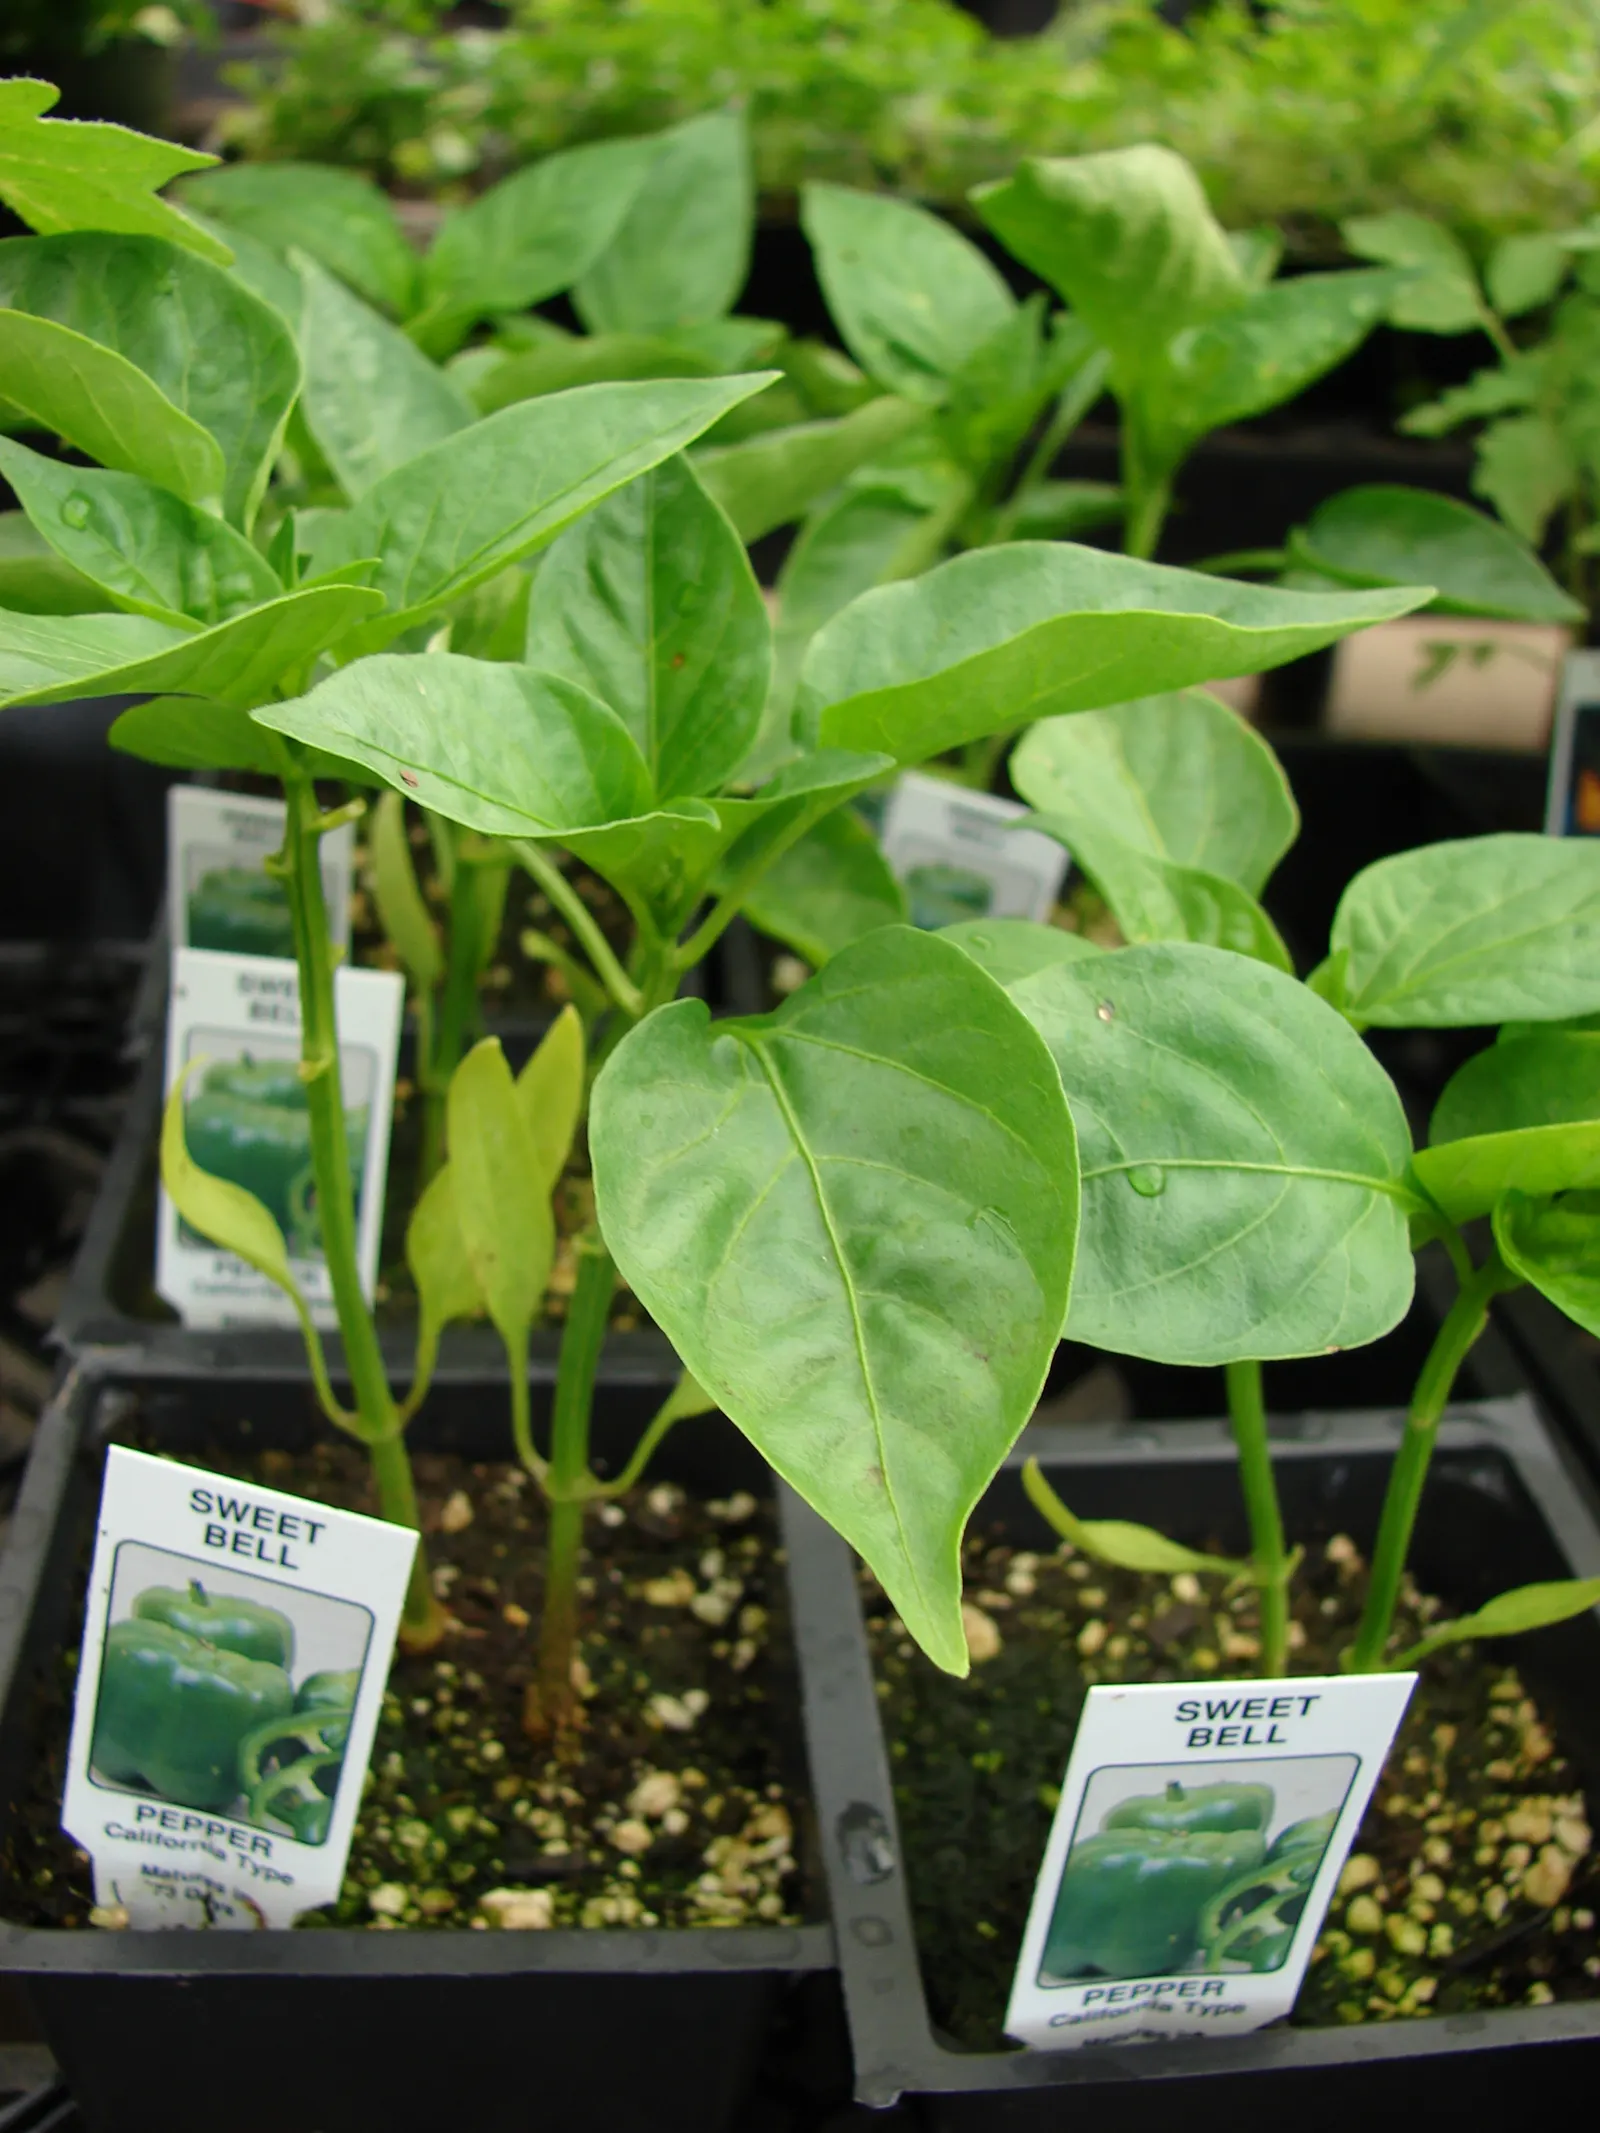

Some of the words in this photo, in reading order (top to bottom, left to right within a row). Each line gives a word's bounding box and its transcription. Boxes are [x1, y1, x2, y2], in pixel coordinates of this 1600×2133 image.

[189, 1488, 326, 1544] SWEET
[203, 1522, 299, 1570] BELL
[1174, 1695, 1321, 1722] SWEET
[1186, 1724, 1287, 1747] BELL
[136, 1803, 273, 1858] PEPPER
[103, 1821, 226, 1861] California
[238, 1852, 295, 1886] Type
[1083, 1980, 1226, 2006] PEPPER
[1049, 1999, 1173, 2027] California
[1184, 2000, 1247, 2018] Type
